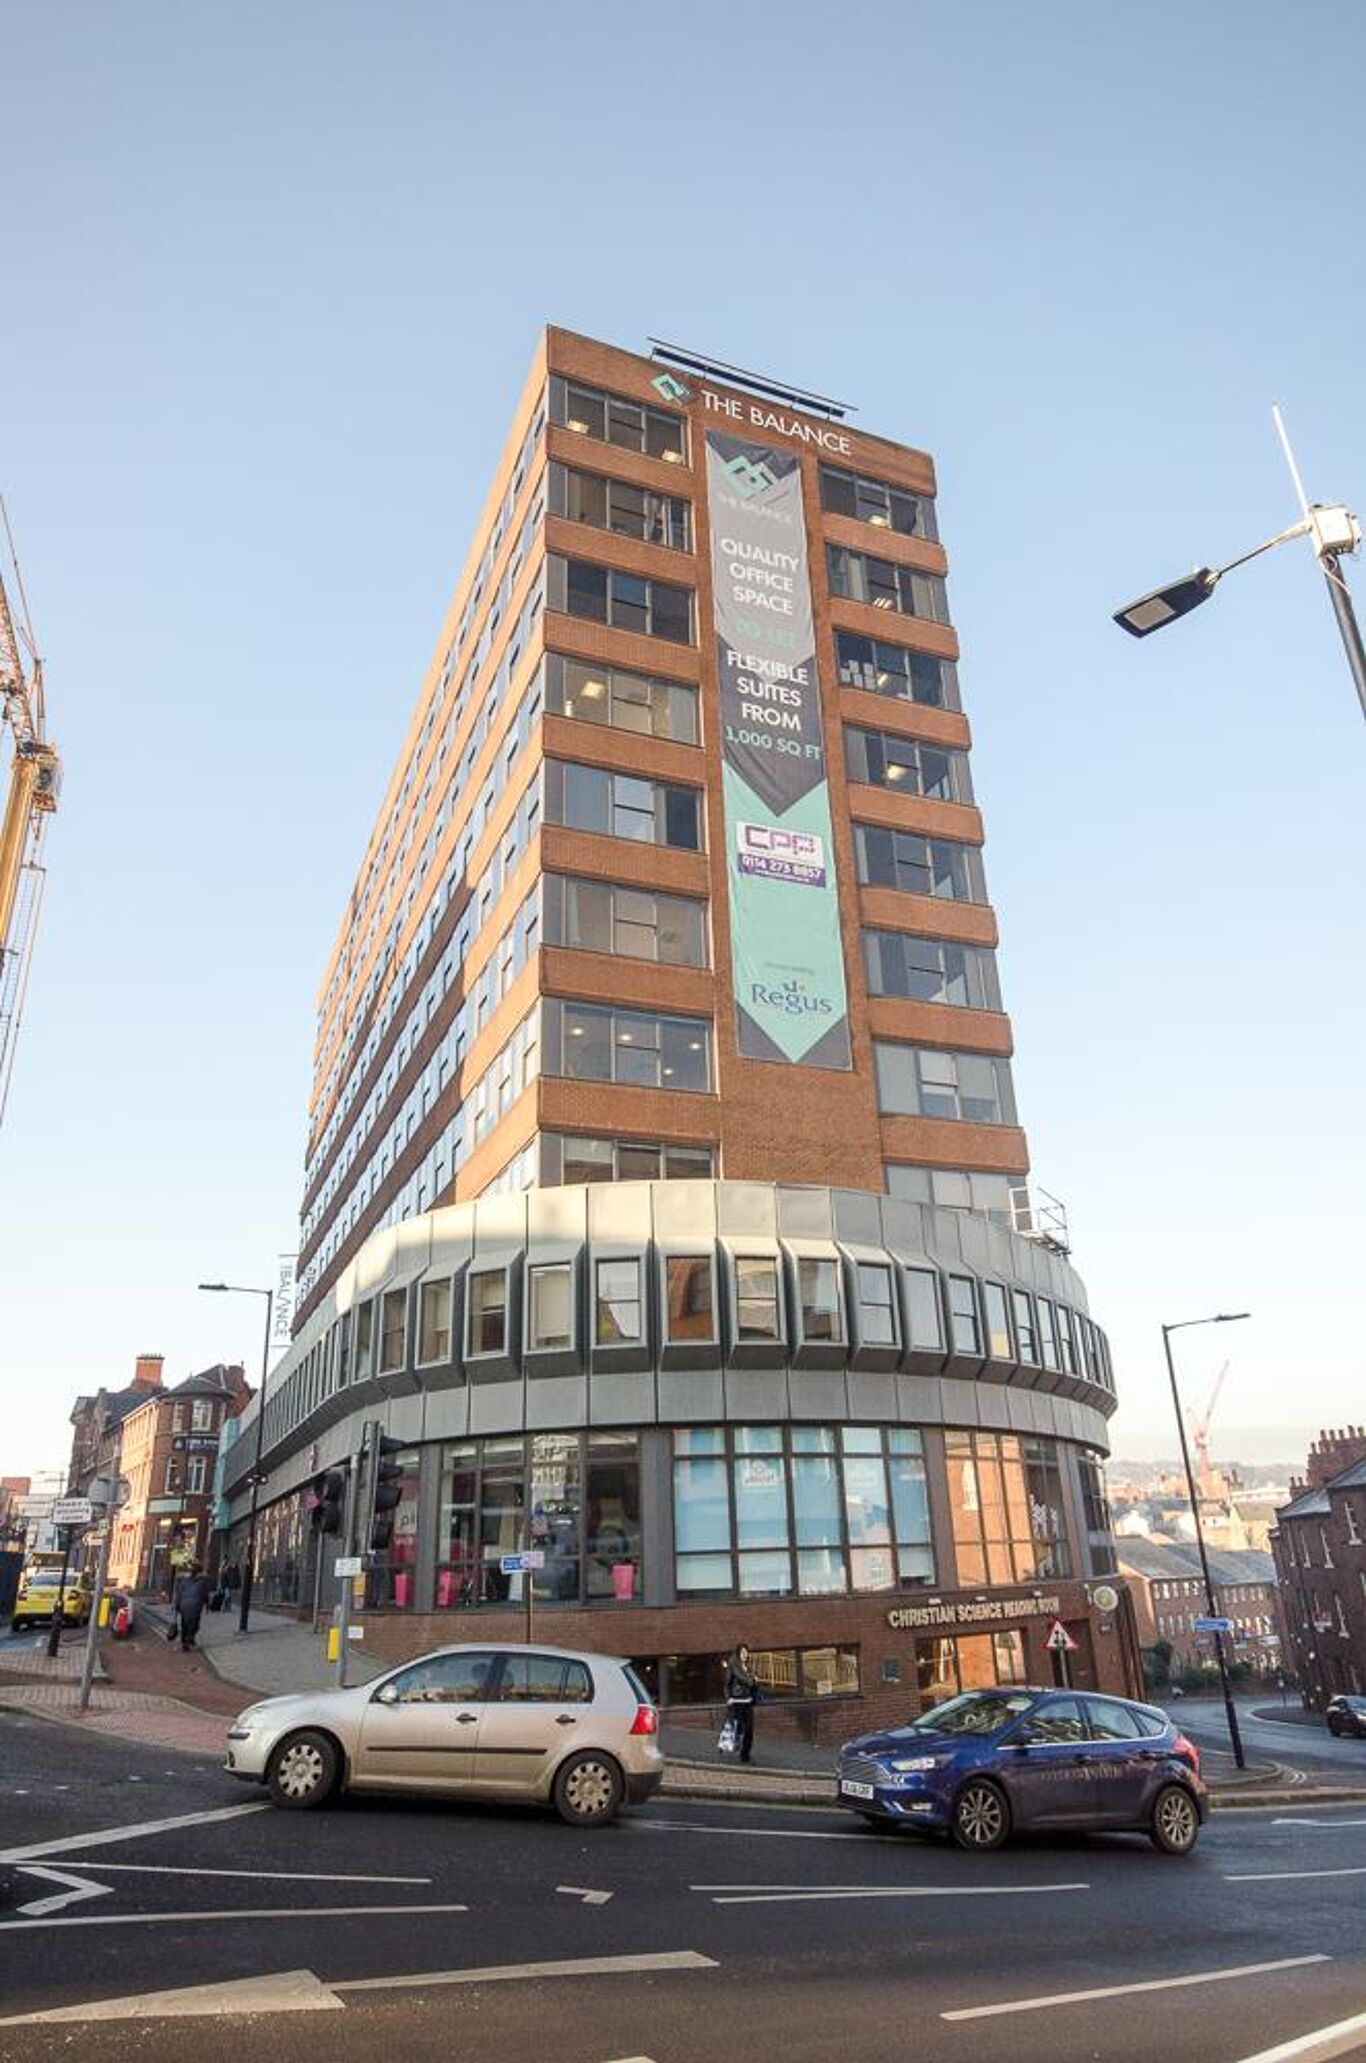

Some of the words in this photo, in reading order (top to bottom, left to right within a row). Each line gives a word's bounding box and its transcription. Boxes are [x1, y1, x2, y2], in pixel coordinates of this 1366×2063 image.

[701, 389, 743, 420] THE
[750, 406, 851, 454] BALANCE
[721, 538, 799, 571] QUALITY
[730, 562, 793, 592] OFFICE
[733, 585, 793, 615] SPACE
[726, 649, 809, 685] FLEXIBLE
[736, 676, 801, 706] SUITES
[741, 702, 801, 731] FROM
[777, 738, 801, 757] SQ
[804, 744, 822, 760] FT
[752, 982, 833, 1015] Regus
[888, 1605, 956, 1628] CHRISTIAN
[957, 1601, 1003, 1622] SCIENCE
